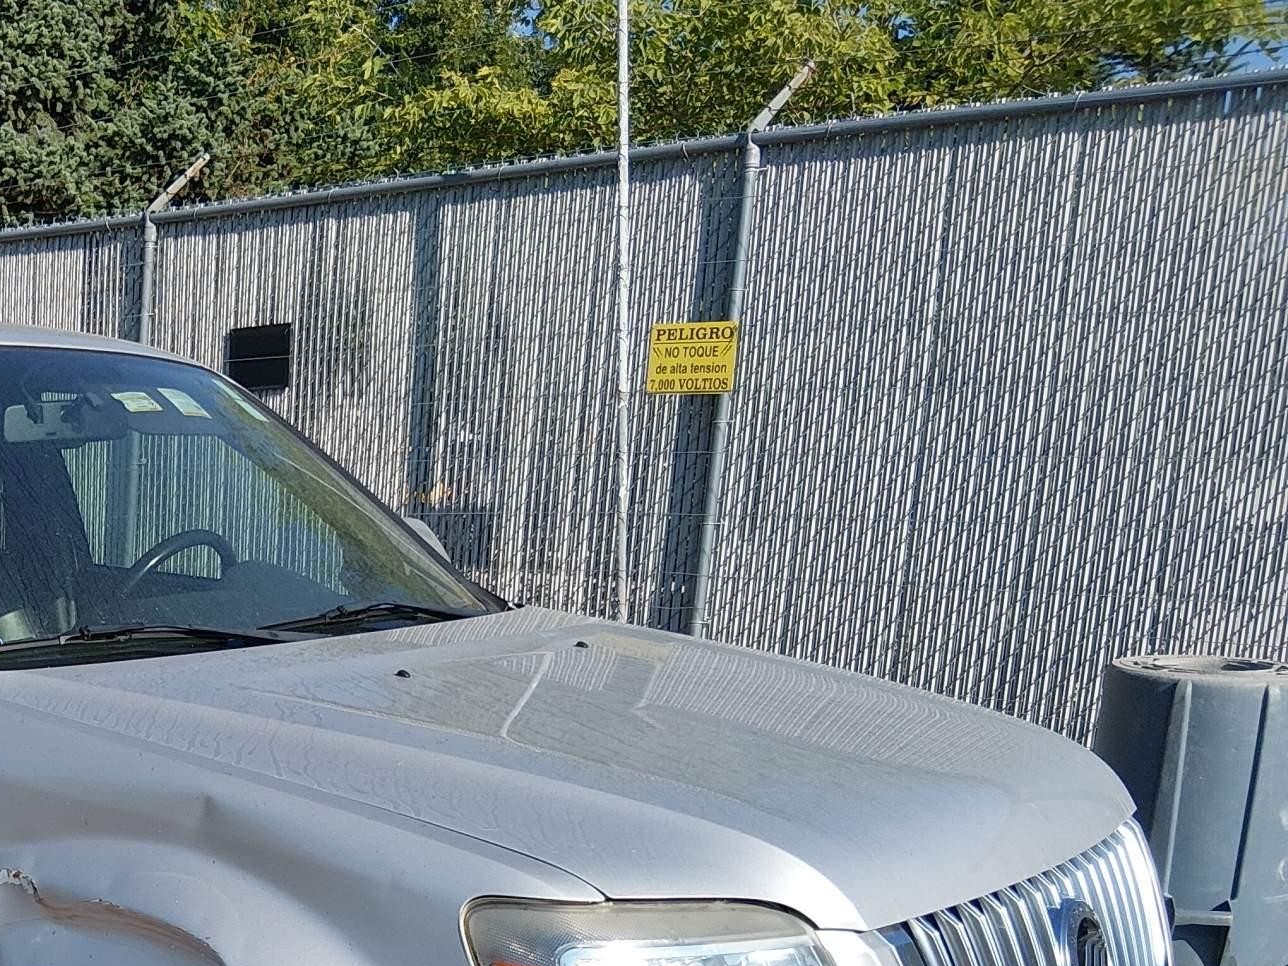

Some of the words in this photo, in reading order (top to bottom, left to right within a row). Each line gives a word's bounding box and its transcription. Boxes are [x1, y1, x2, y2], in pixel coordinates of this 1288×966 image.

[655, 326, 734, 341] PELIGRO
[664, 346, 680, 358] NO
[683, 345, 719, 358] TOQUE
[655, 363, 667, 374] de
[670, 362, 687, 374] alta
[690, 362, 727, 374] tension
[650, 379, 675, 391] 7,000
[678, 377, 729, 390] VOLTIOS
